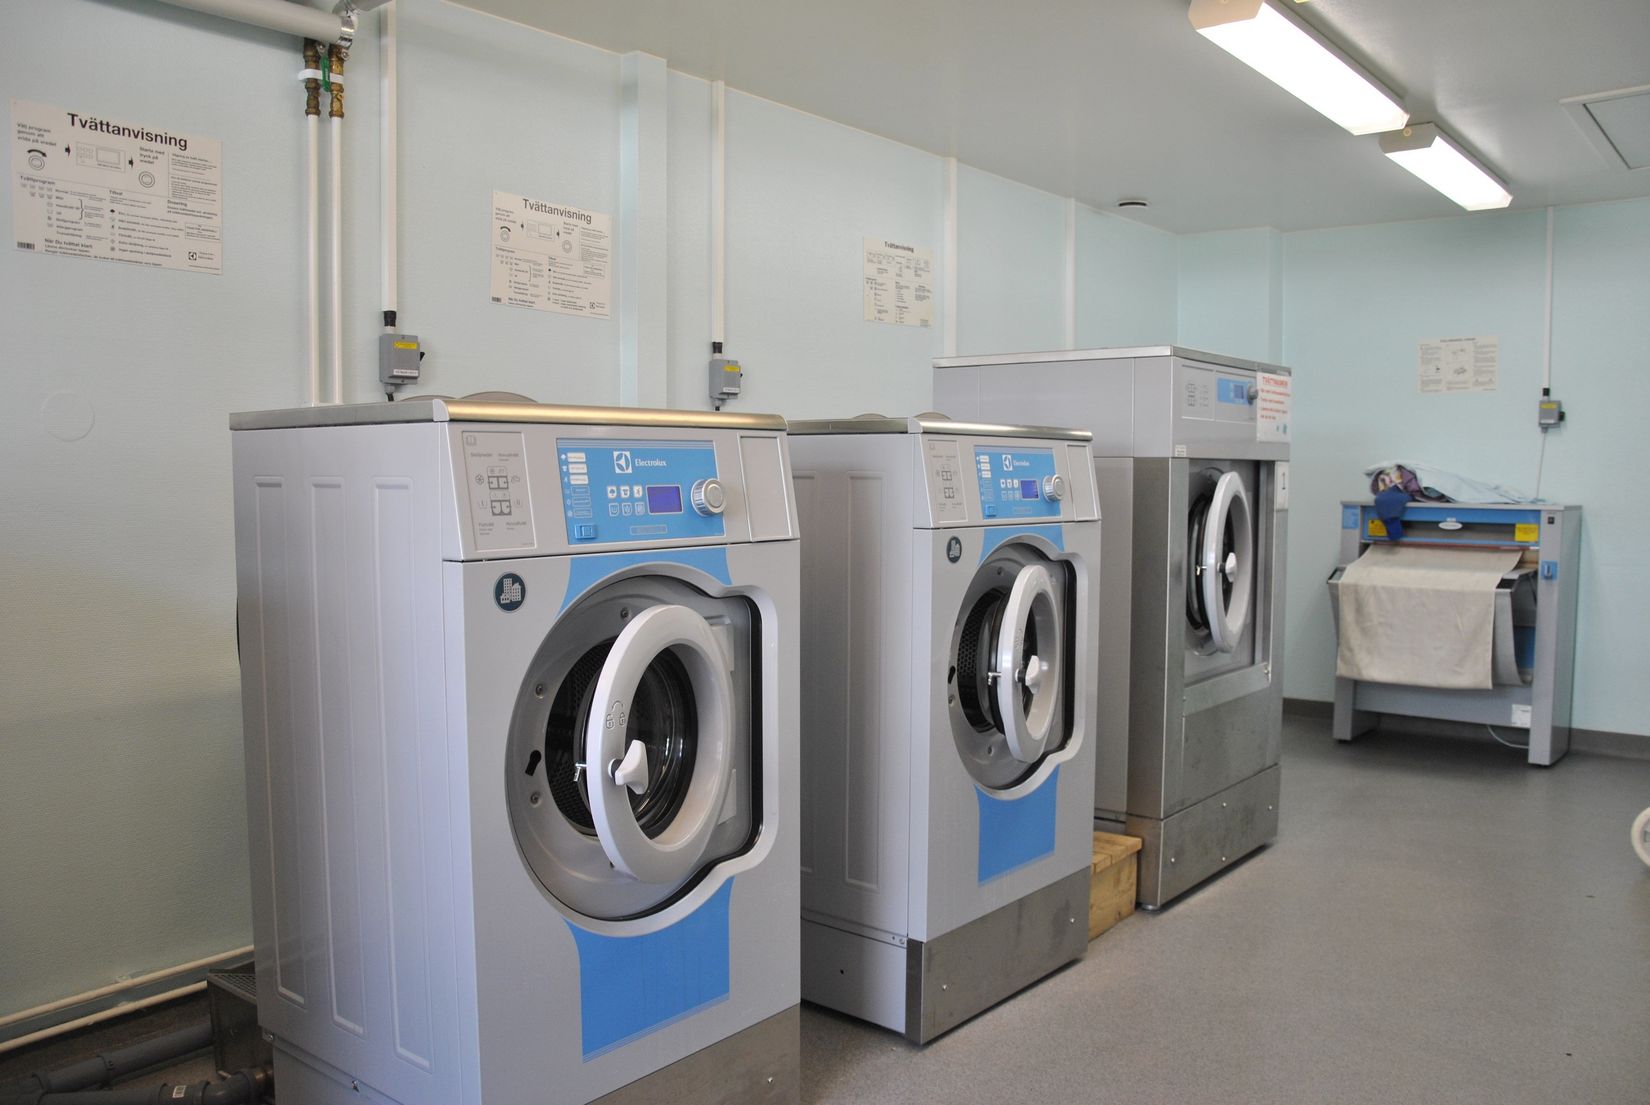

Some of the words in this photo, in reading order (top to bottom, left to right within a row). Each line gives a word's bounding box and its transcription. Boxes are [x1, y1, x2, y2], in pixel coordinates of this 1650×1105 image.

[67, 112, 188, 151] Tvättanvisning
[523, 198, 592, 225] Tvättanvisning
[635, 459, 667, 467] Electrolux
